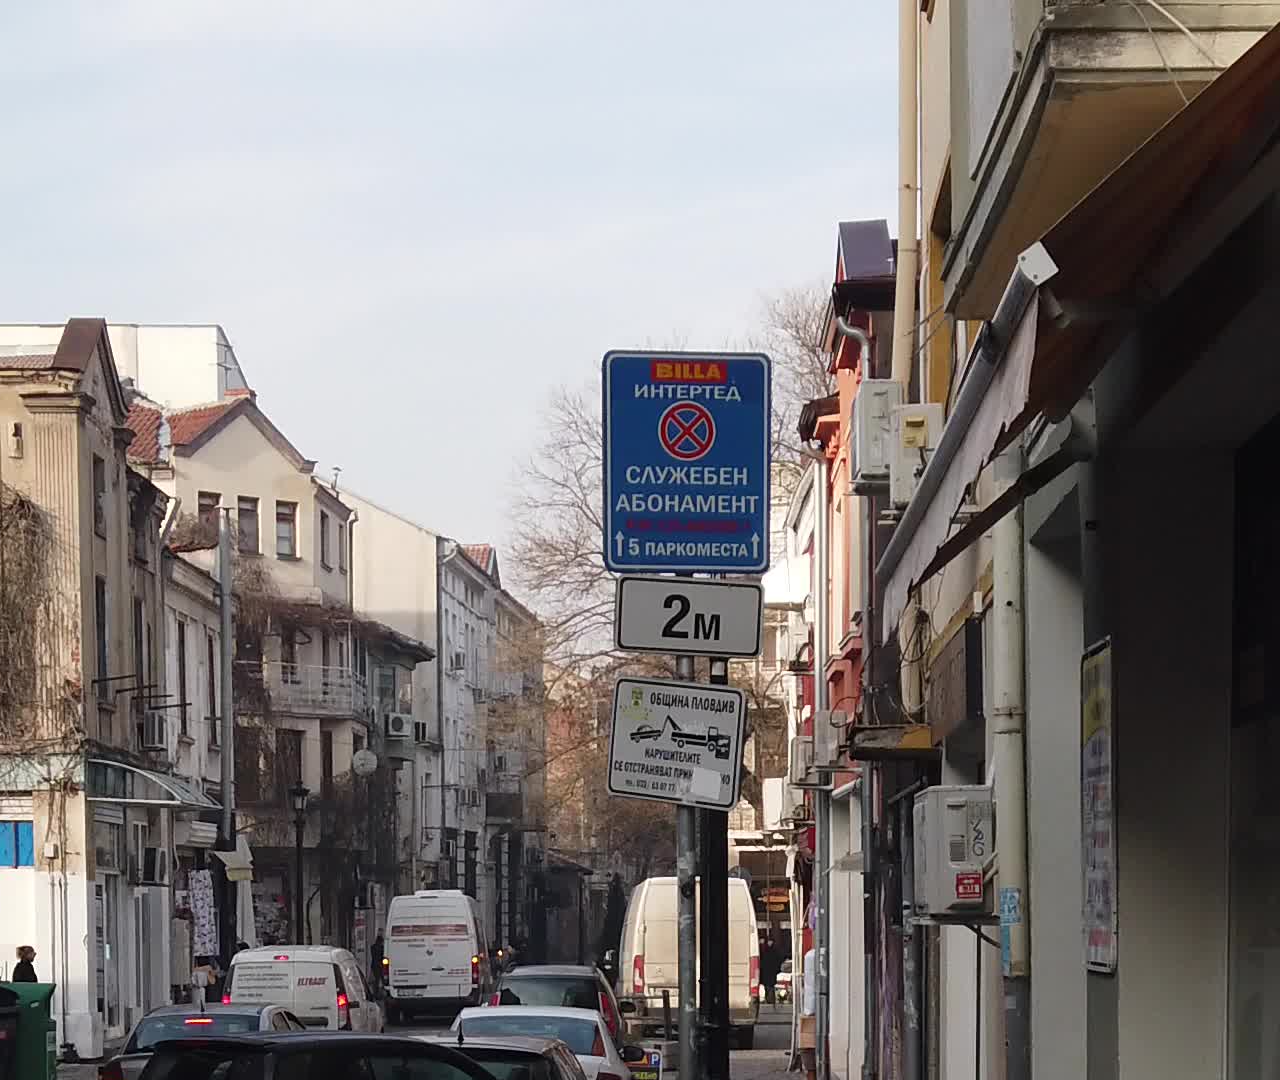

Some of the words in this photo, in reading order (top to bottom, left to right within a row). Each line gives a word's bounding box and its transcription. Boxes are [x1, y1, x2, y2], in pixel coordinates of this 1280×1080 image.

[655, 363, 721, 379] BILLA
[634, 384, 741, 401] ИНТЕРТЕД
[625, 465, 748, 486] СЛУЖЕБЕН
[615, 493, 759, 514] АБОНАМЕНТ
[628, 538, 640, 556] 5
[645, 541, 749, 557] ПАРКОМЕСТА
[650, 692, 690, 709] ОБЩИНА
[691, 696, 735, 714] ПЛОВДИВ
[645, 747, 701, 765] НАРУШИТЕЛИТЕ
[614, 760, 624, 772] СЕ
